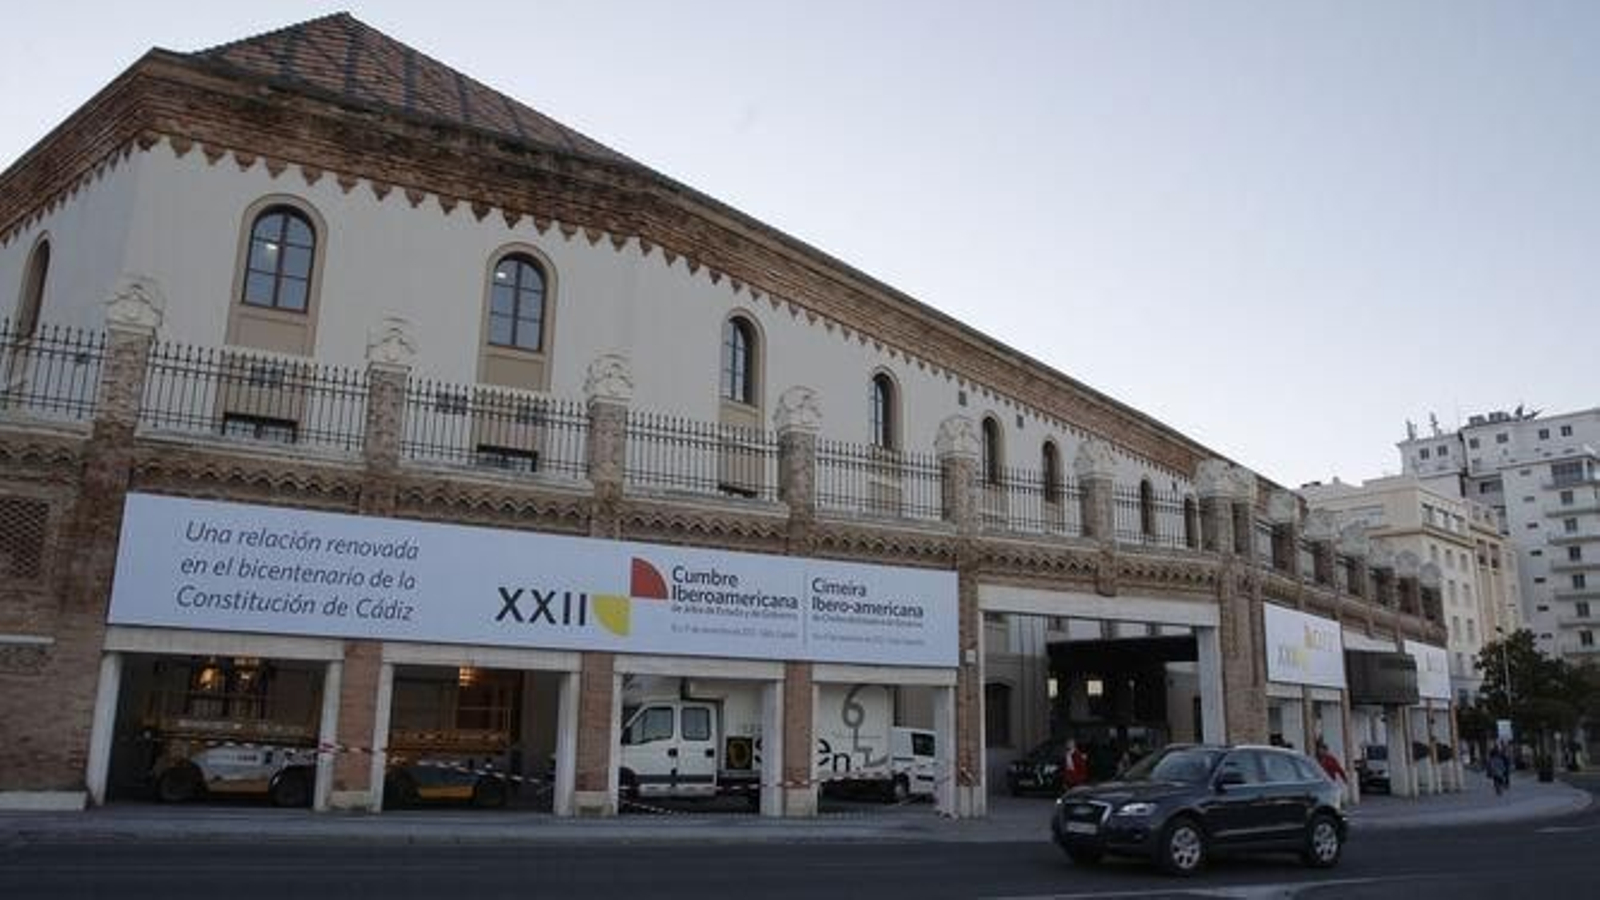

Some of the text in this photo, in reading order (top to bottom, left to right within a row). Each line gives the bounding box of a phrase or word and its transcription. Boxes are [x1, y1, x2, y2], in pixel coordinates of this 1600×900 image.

[185, 520, 420, 560] Una relación renovada
[181, 553, 416, 591] en el bicentenario de la
[672, 566, 739, 586] Cumbre
[812, 577, 867, 597] Cimeira
[176, 584, 414, 622] Constitución de Cádiz
[495, 586, 587, 627] XXII
[672, 584, 798, 609] Iberoamericana
[812, 596, 924, 618] Ibero-americana
